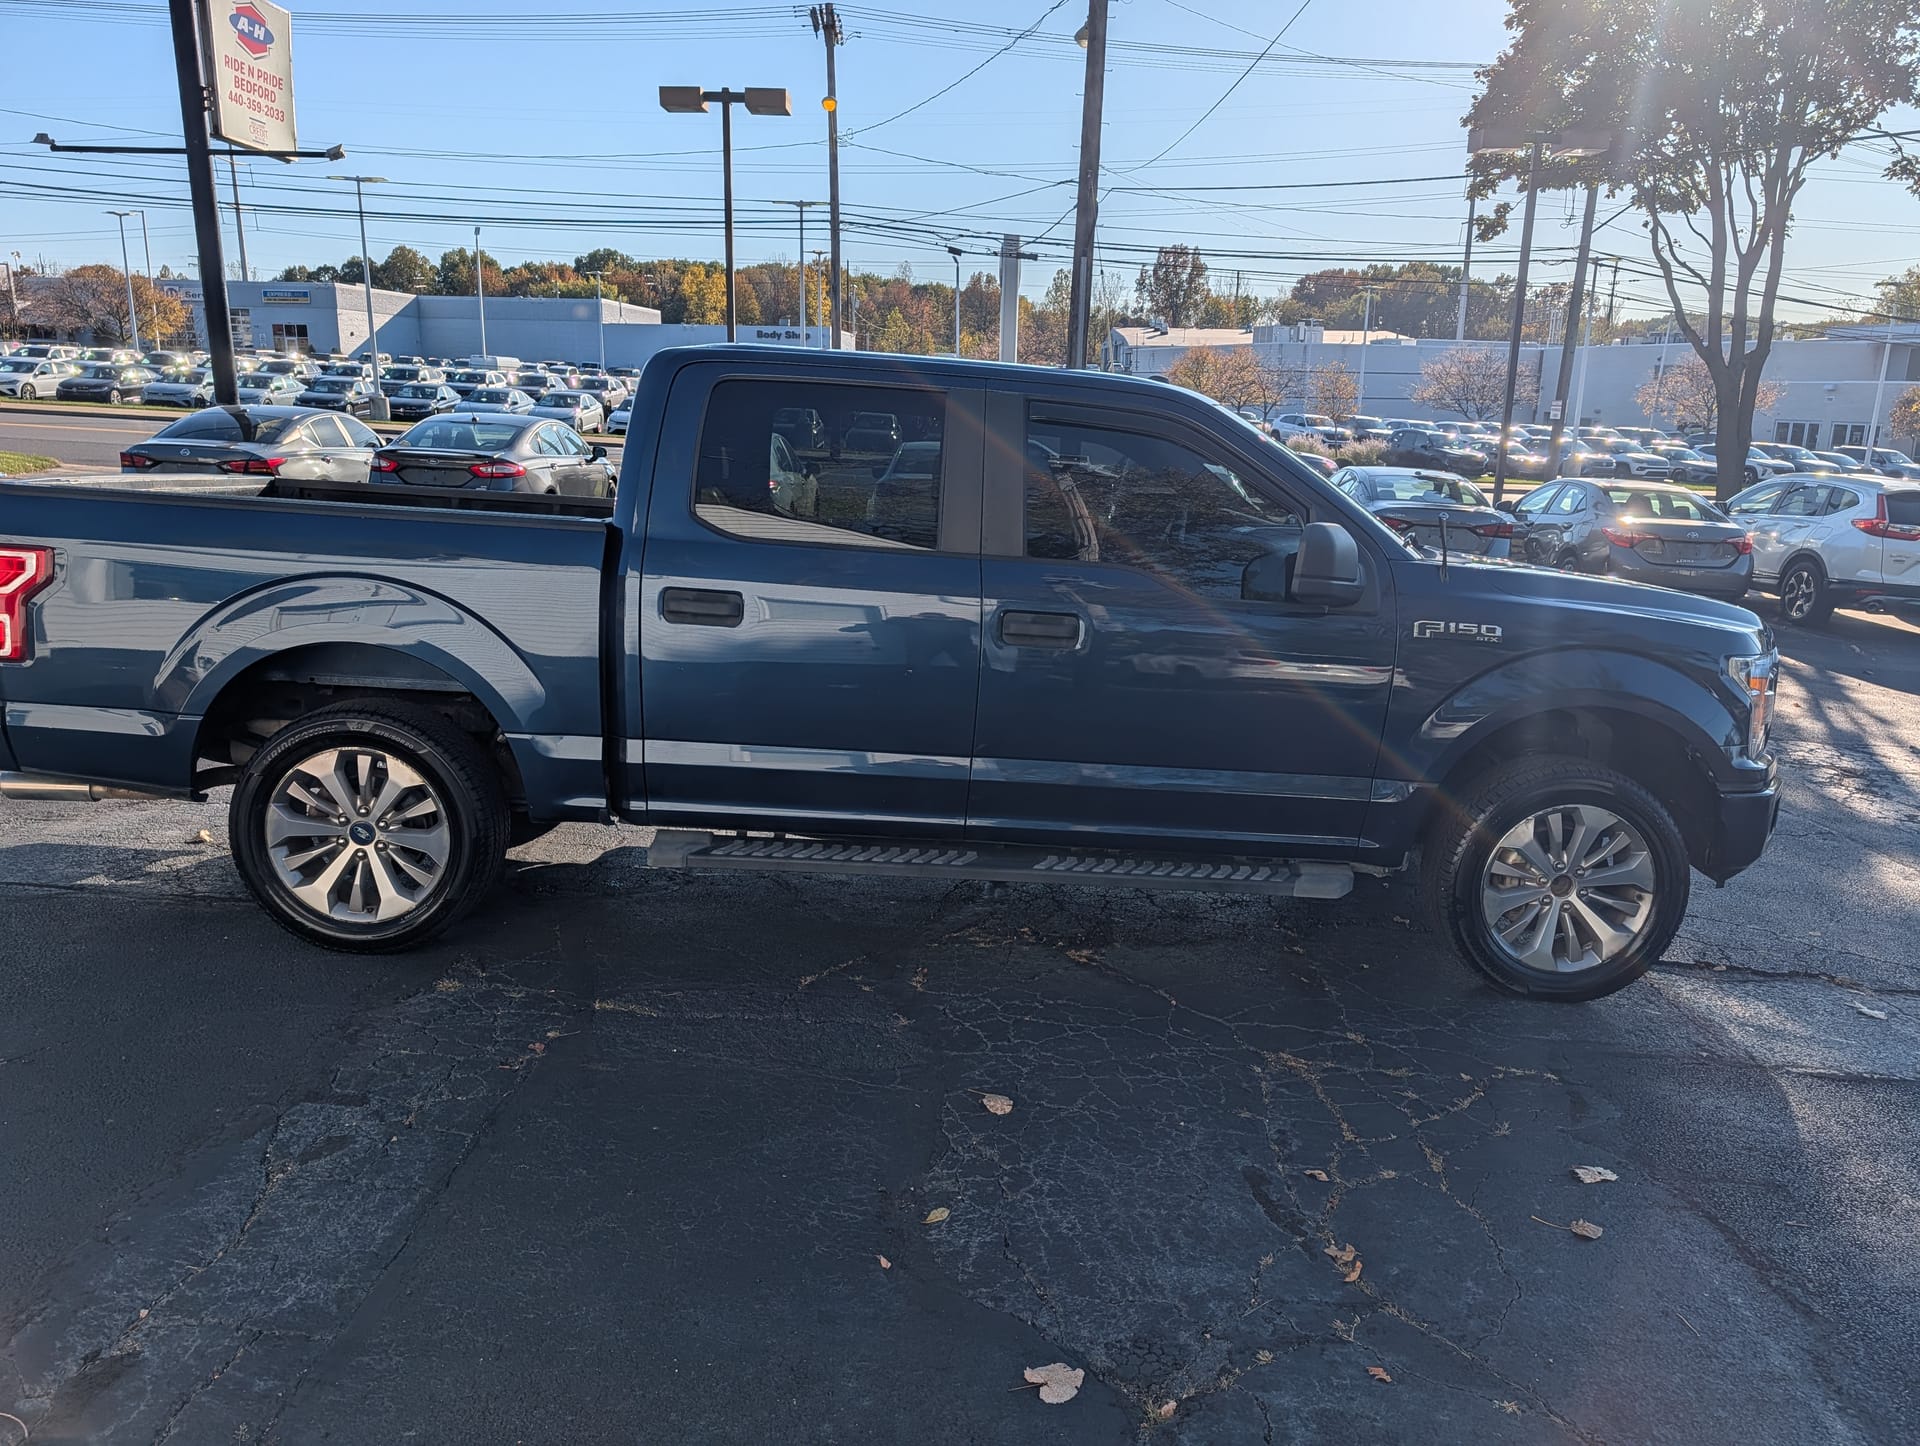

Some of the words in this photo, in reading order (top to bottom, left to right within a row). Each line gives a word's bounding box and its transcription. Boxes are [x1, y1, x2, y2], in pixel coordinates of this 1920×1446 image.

[237, 15, 266, 41] A-H
[224, 54, 246, 75] RIDE
[247, 64, 255, 79] N
[257, 68, 284, 91] PRIDE
[233, 74, 277, 104] BEDFORD
[228, 90, 285, 122] 440-359-2033
[756, 330, 782, 340] Body
